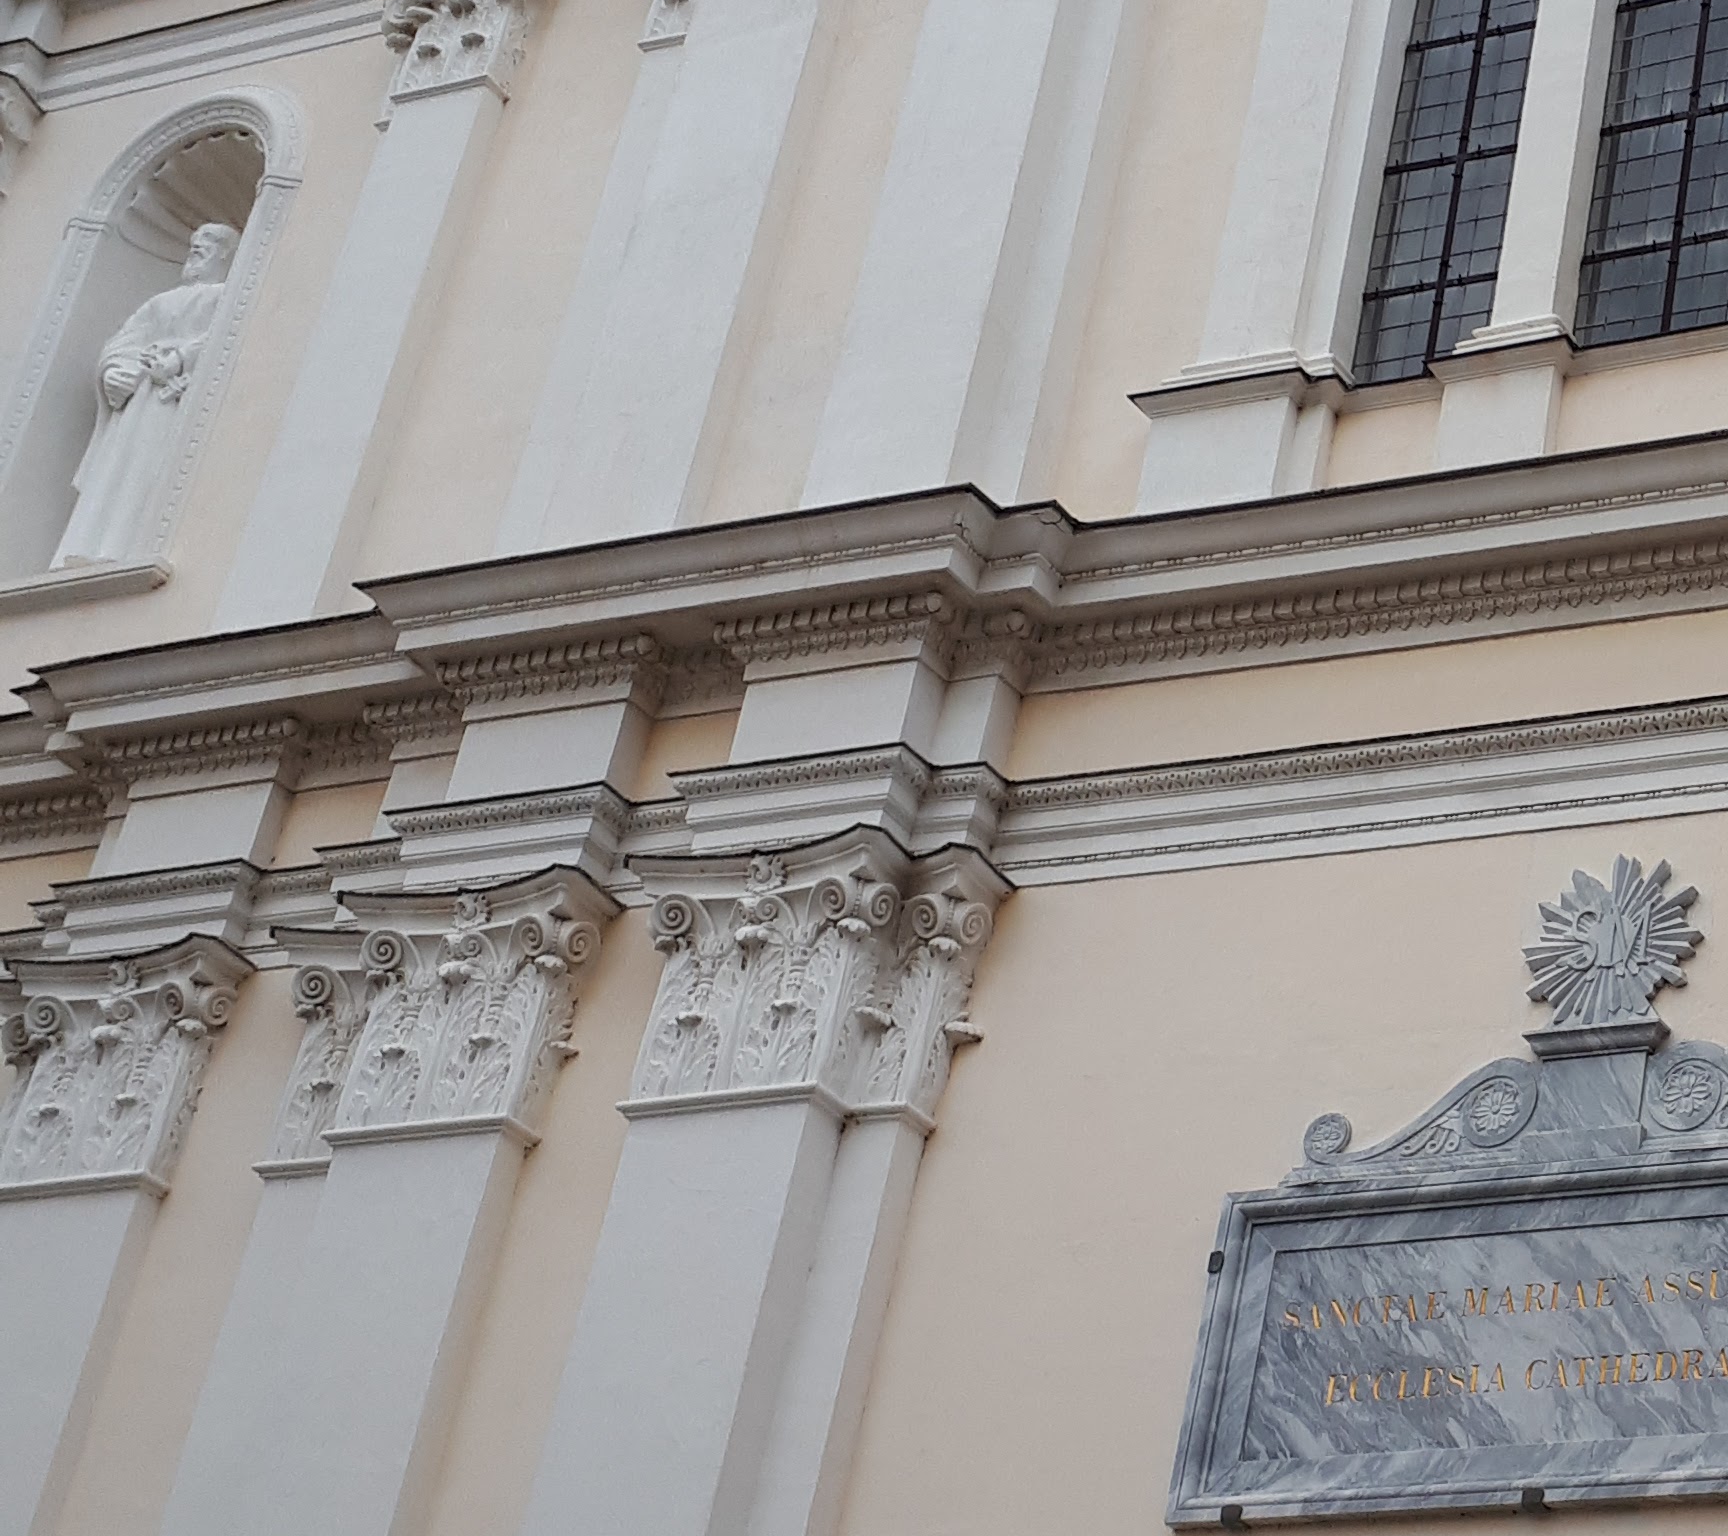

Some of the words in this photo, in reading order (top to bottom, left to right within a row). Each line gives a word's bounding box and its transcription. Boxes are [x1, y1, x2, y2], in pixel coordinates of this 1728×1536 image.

[1284, 1291, 1448, 1329] SANCTAE
[1462, 1277, 1616, 1317] MARIAE
[1325, 1362, 1506, 1405] ECCLESIA
